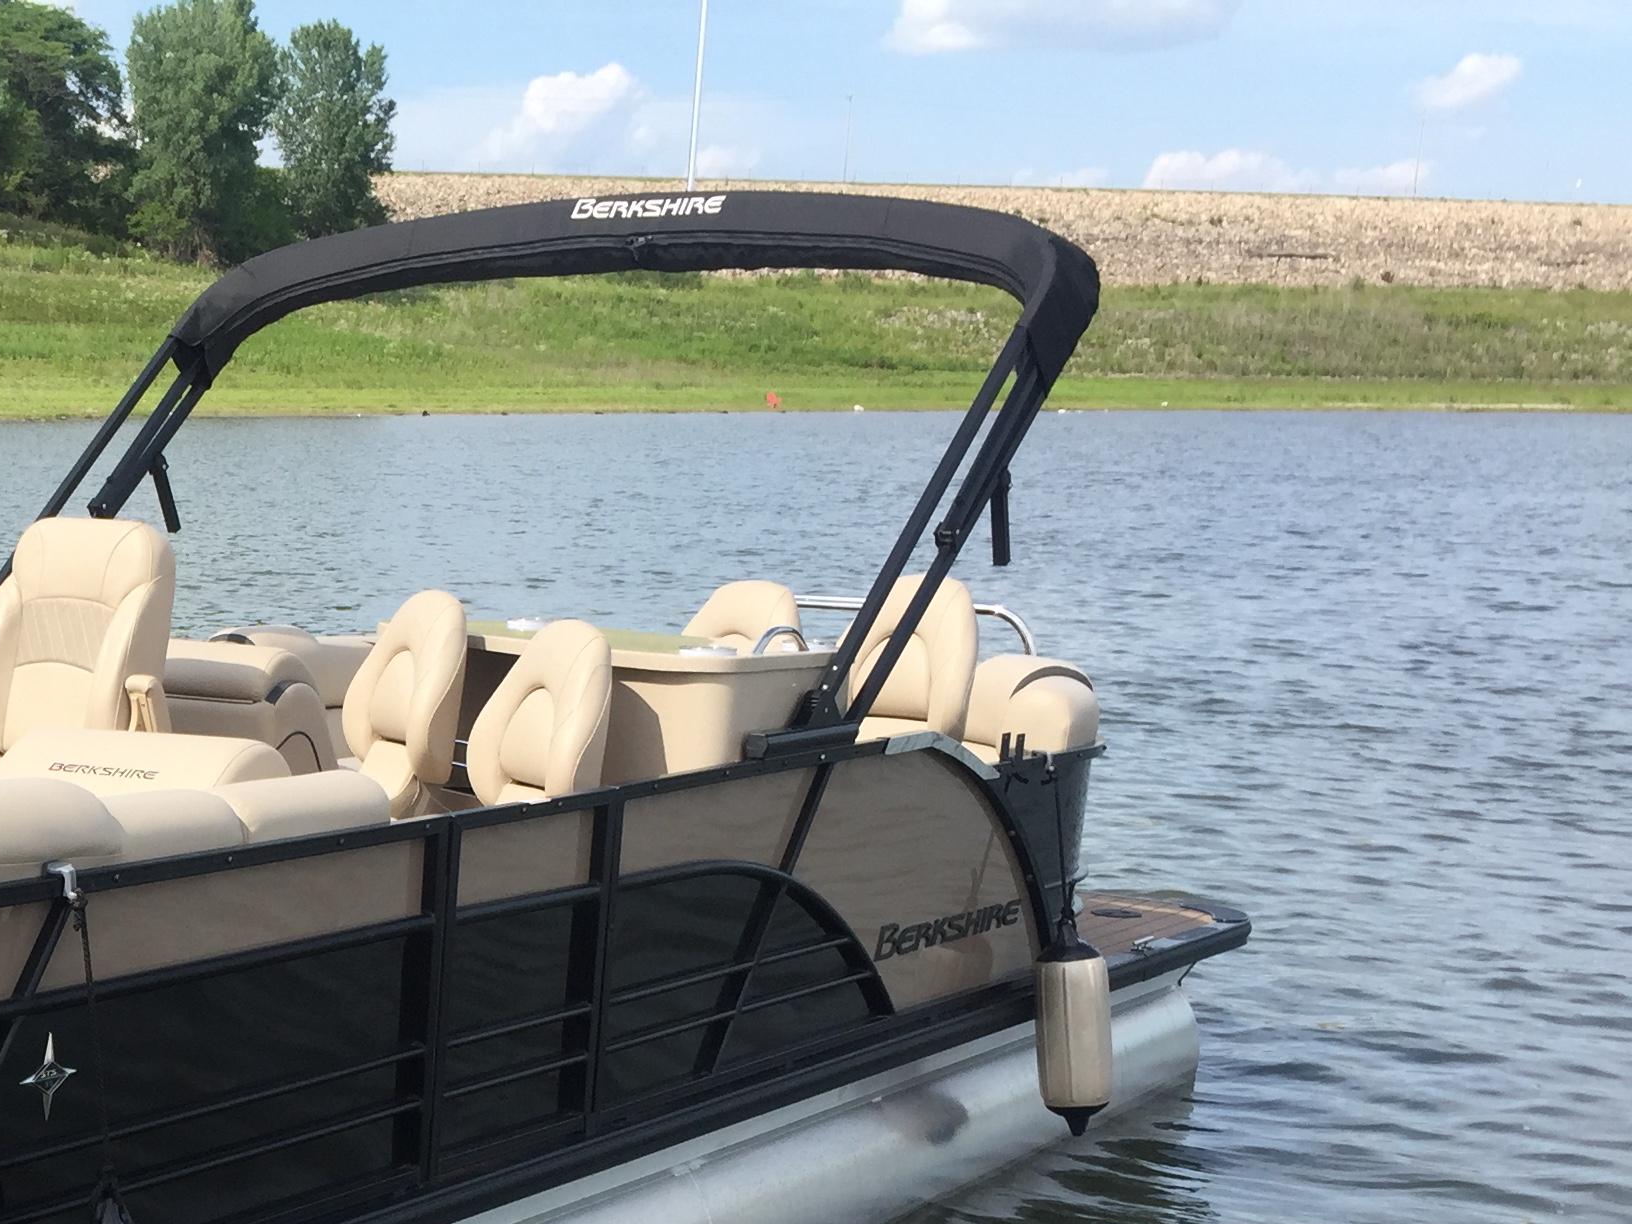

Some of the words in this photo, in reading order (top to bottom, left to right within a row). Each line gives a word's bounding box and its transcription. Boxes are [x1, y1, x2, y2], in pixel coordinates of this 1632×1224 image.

[571, 195, 726, 219] BERKSHIRE
[48, 762, 159, 779] BERKSHIRE
[874, 899, 1022, 962] BERKSHIRE
